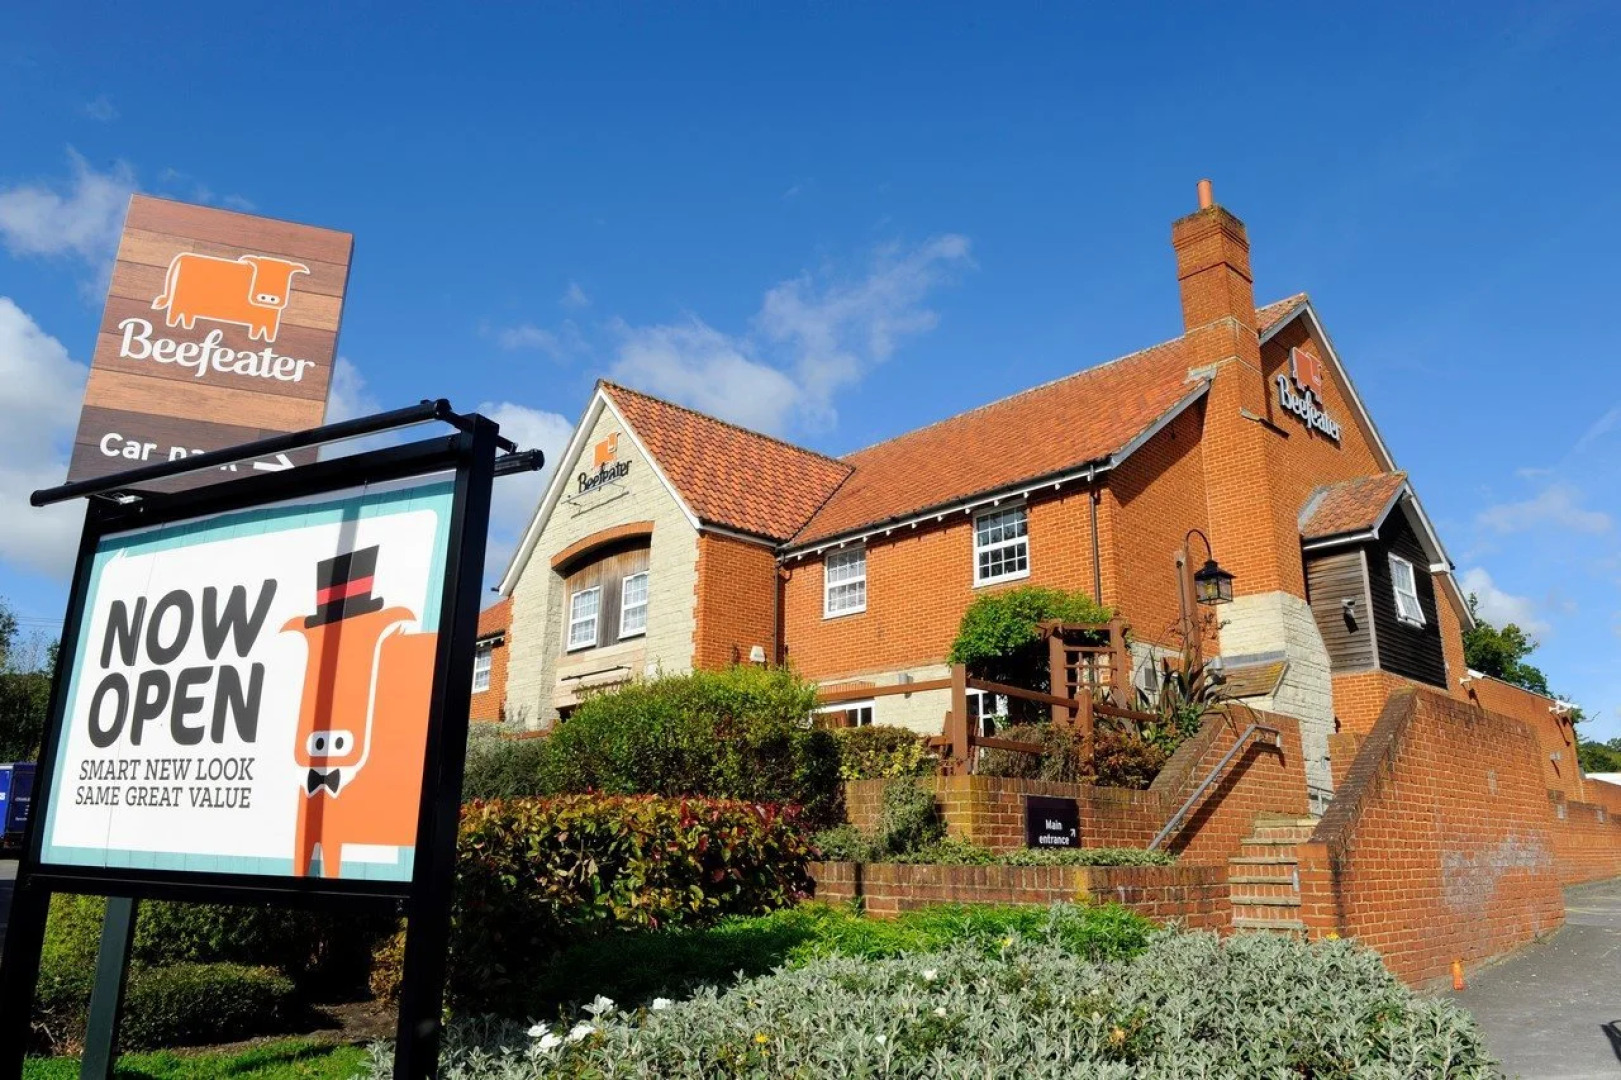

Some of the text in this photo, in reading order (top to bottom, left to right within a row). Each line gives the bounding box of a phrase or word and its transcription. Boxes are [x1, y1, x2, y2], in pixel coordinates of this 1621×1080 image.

[118, 317, 315, 383] Beefeater
[1277, 373, 1341, 441] Beefeater
[100, 433, 157, 461] Car
[578, 460, 632, 493] Beefeater
[100, 578, 278, 669] NOW
[88, 662, 265, 748] OPEN
[79, 757, 255, 781] SMART NEW LOOK
[75, 785, 252, 809] SAME GREAT VALUE
[1039, 834, 1070, 845] entrance
[1045, 819, 1063, 830] Main
